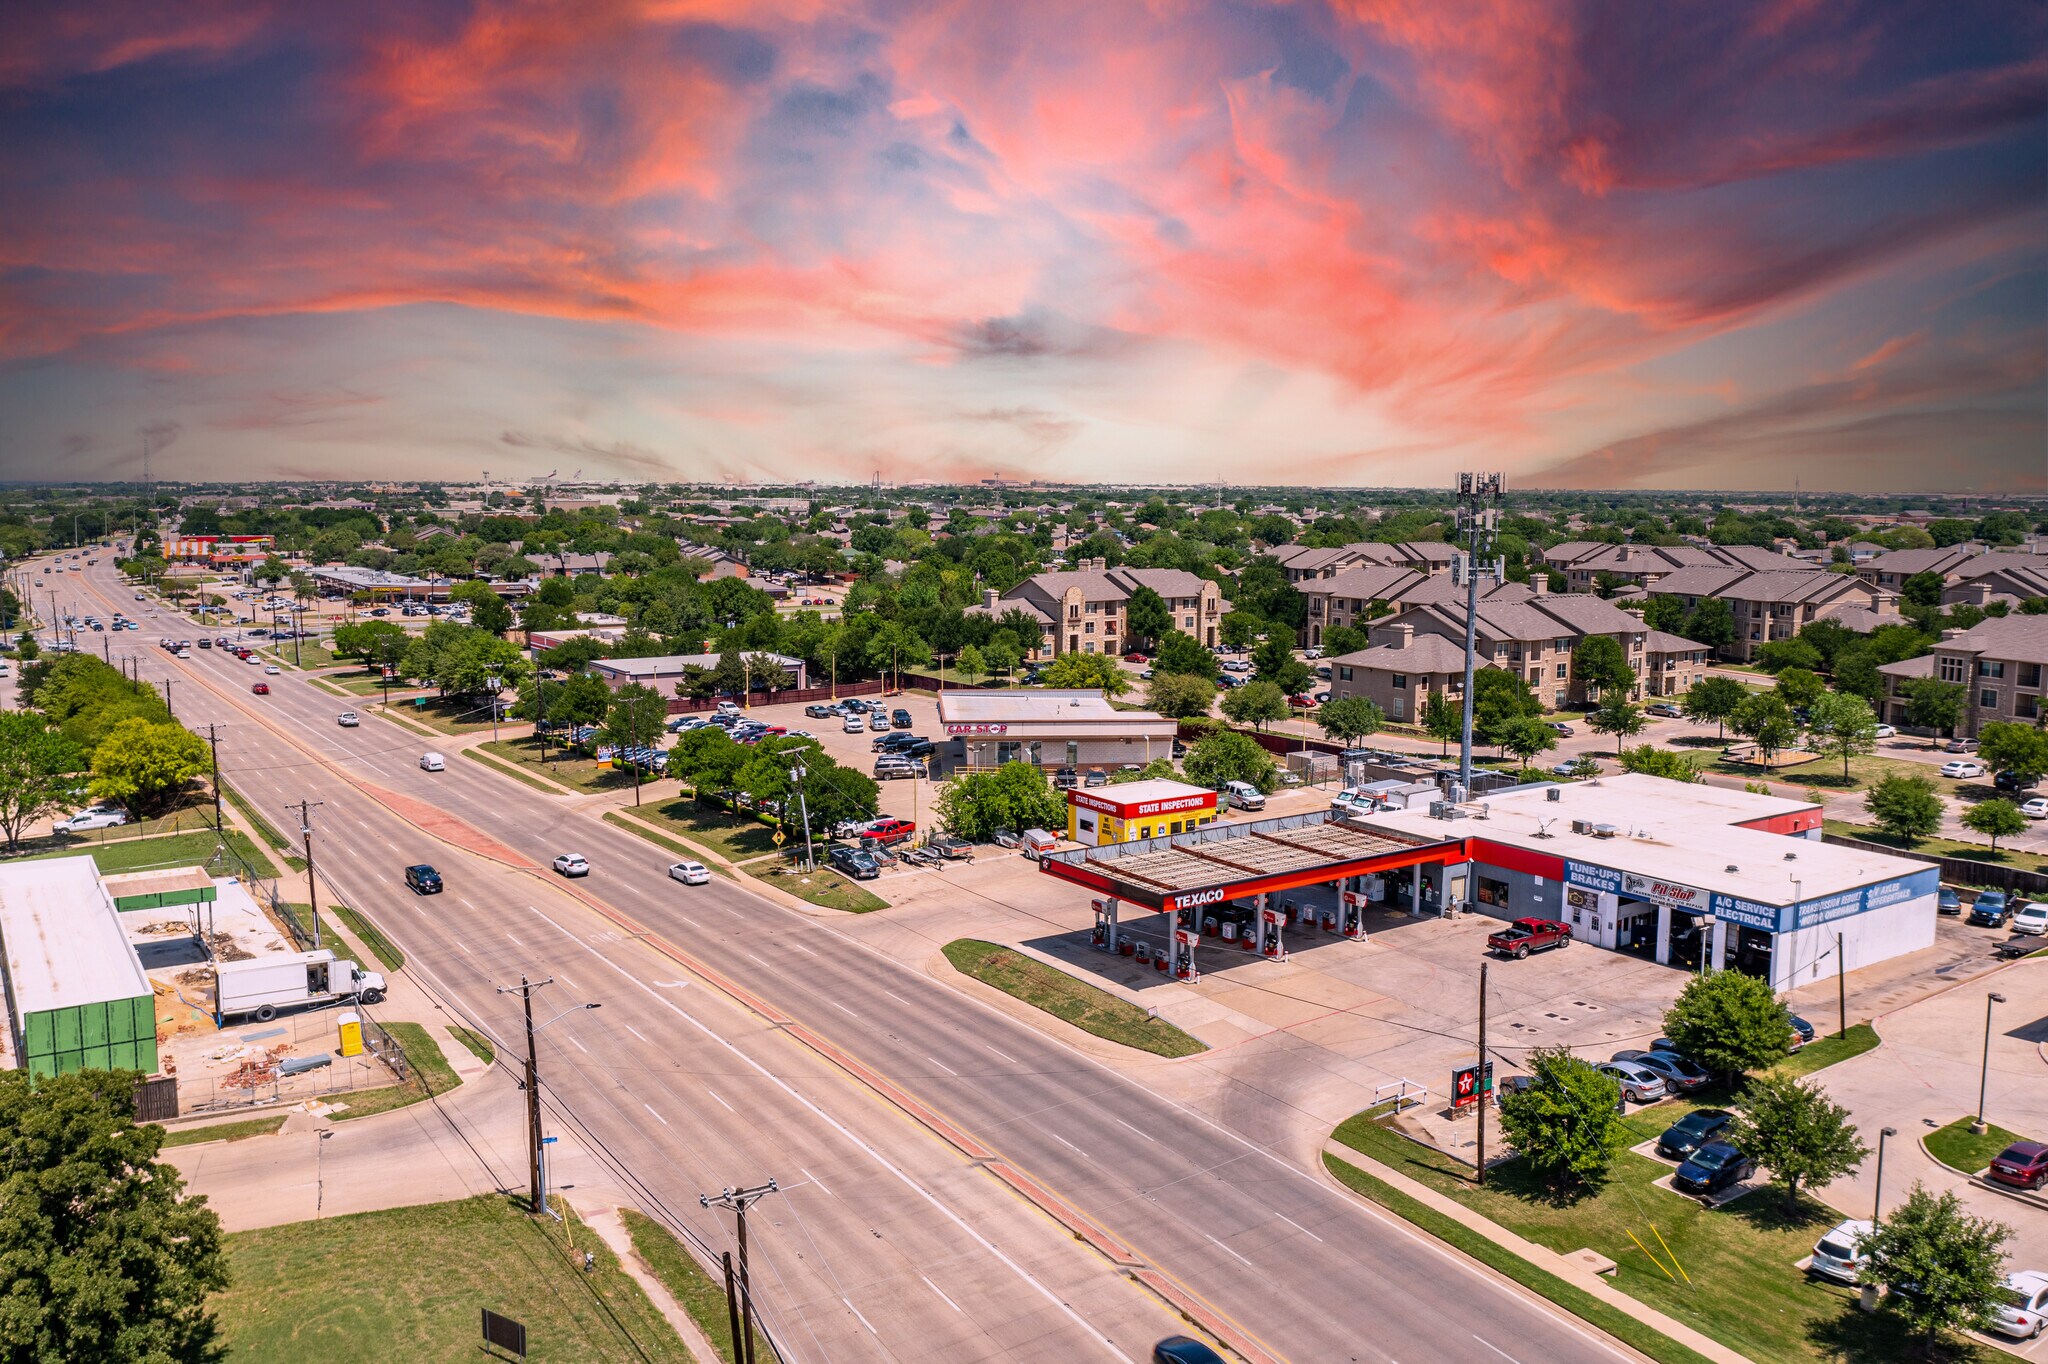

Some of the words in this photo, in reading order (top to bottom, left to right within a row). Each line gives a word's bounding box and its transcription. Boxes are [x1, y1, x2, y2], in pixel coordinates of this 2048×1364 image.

[948, 725, 971, 734] CAR
[1075, 794, 1089, 805] STATE
[1089, 798, 1117, 813] INSPECTIONS
[1139, 803, 1159, 814] STATE
[1161, 797, 1204, 811] INSPECTIONS
[1571, 872, 1615, 891] BRAKES
[1651, 882, 1669, 895] Pit
[1174, 888, 1224, 909] TEXACO
[1715, 896, 1732, 908] A/C
[1735, 900, 1776, 918] SERVICE
[1715, 906, 1774, 929] ELECTRICAL
